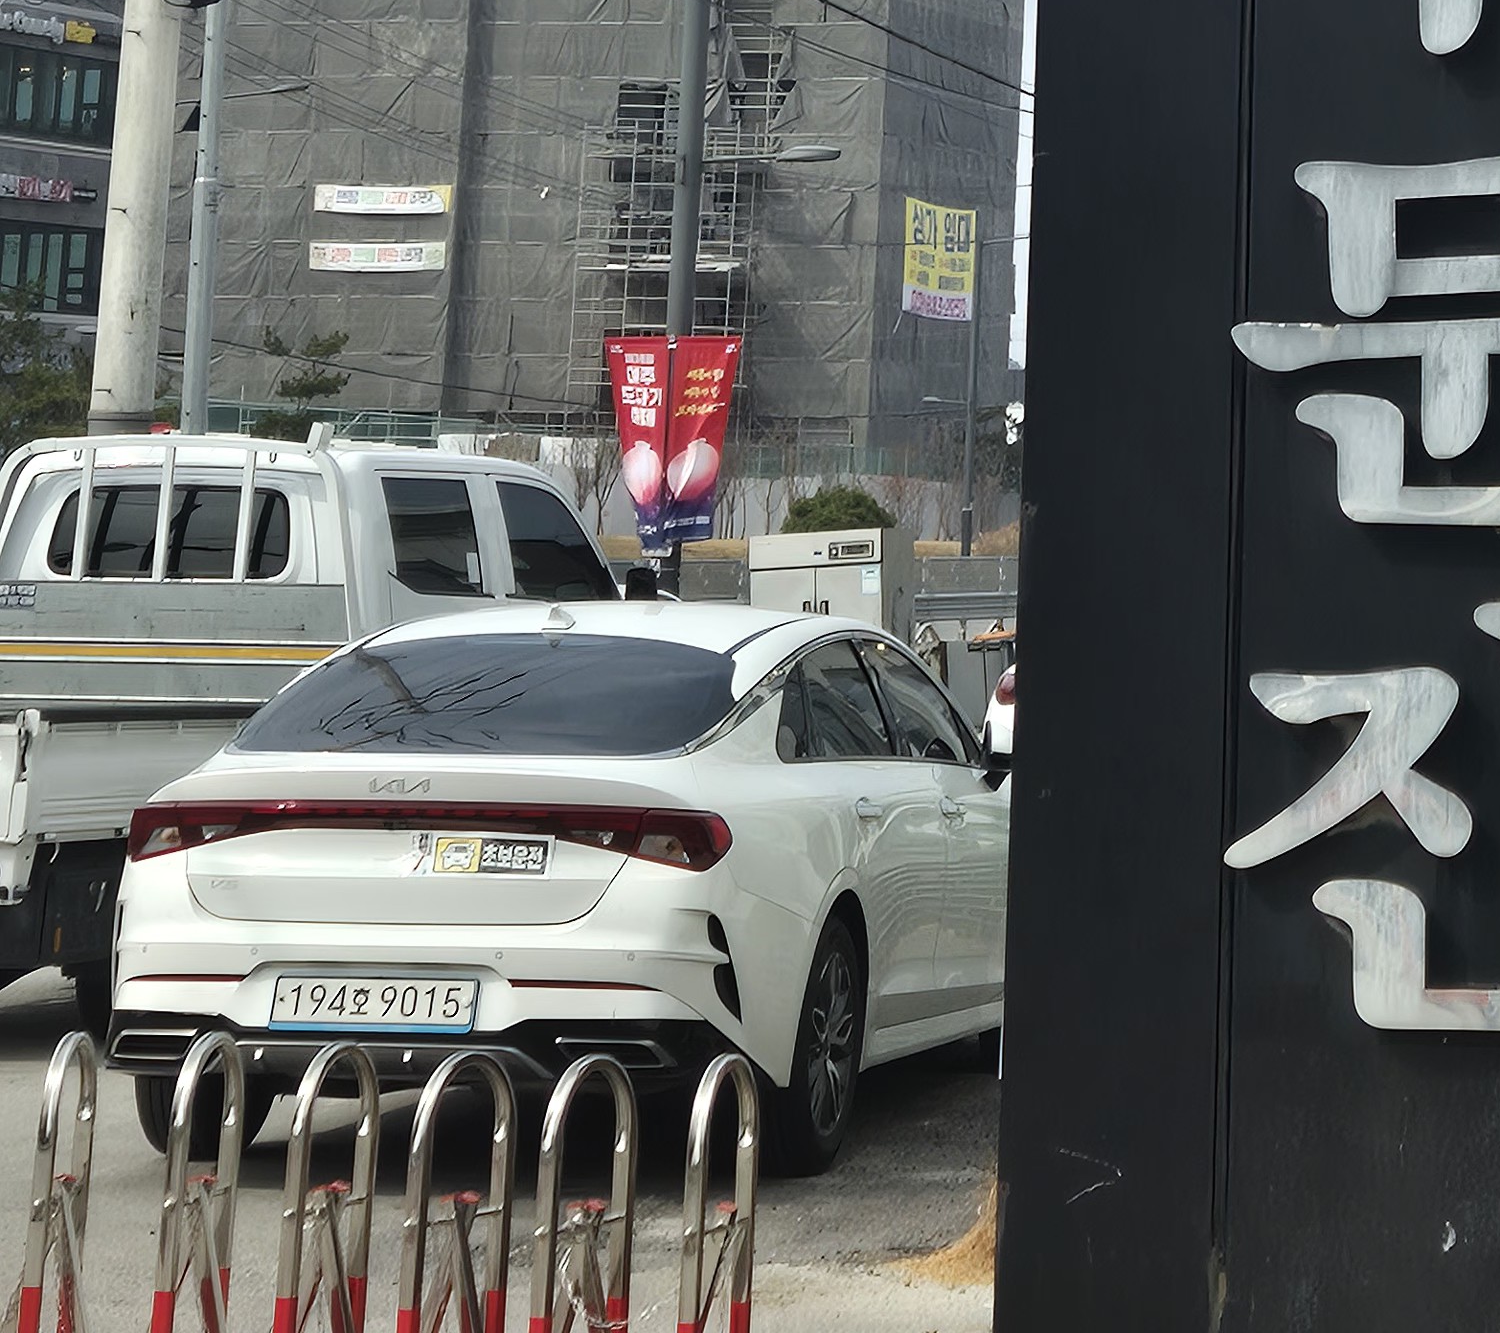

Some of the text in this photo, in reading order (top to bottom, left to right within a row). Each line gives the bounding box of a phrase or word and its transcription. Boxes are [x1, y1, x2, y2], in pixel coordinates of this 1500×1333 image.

[912, 203, 970, 252] 상가 임대
[381, 985, 462, 1019] 9015
